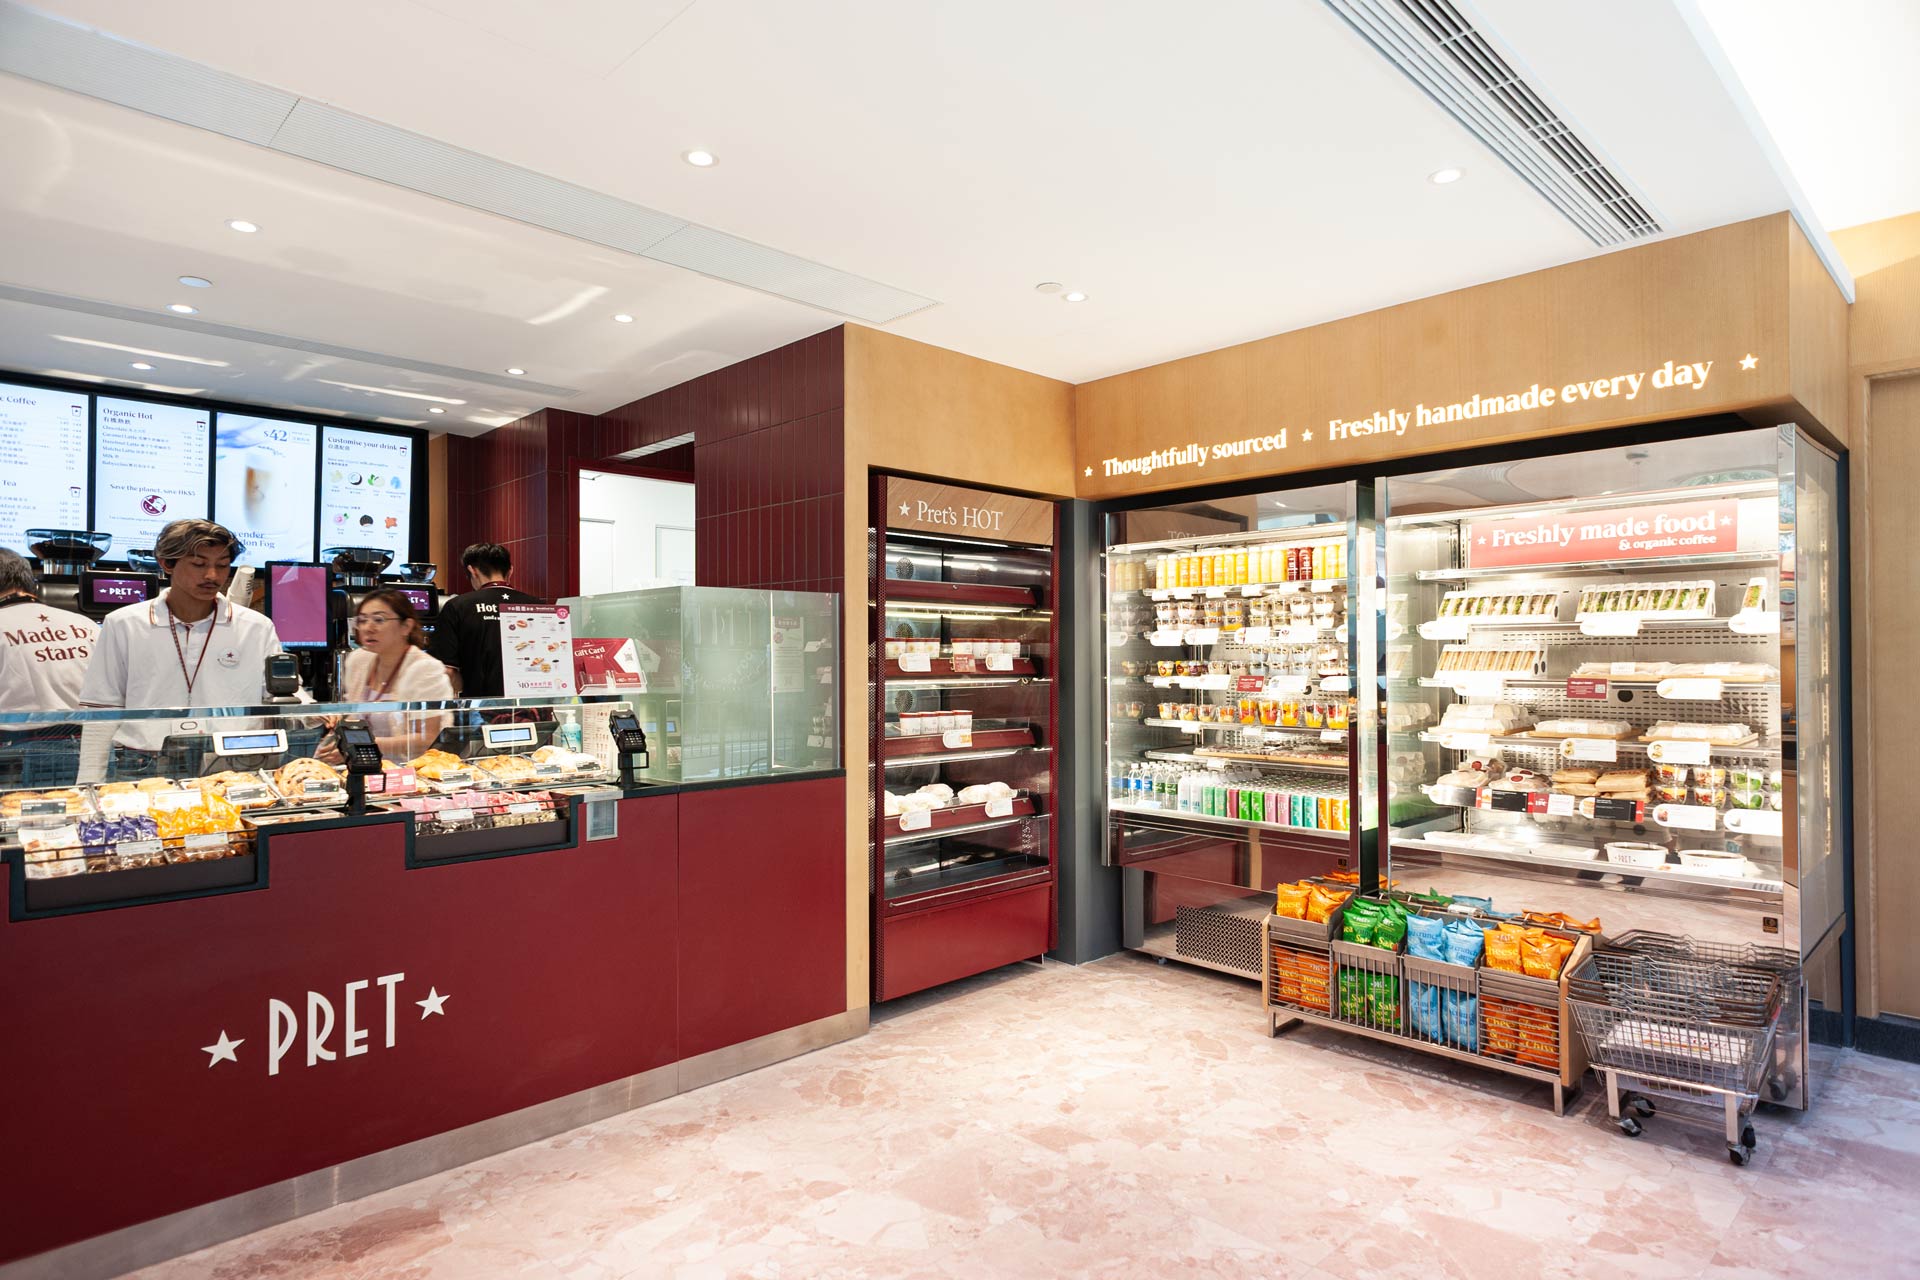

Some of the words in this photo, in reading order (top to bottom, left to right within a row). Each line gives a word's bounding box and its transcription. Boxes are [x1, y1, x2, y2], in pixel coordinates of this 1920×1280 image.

[6, 395, 37, 406] Coffee
[1328, 408, 1412, 441] Freshly
[1415, 383, 1556, 428] handmade
[1560, 371, 1646, 402] every
[1650, 360, 1714, 390] day
[103, 407, 136, 418] Organic
[137, 411, 153, 420] Hot
[328, 436, 362, 447] Customise
[363, 441, 378, 449] your
[379, 443, 398, 451] drink
[1103, 443, 1209, 477] Thoughtfully
[1212, 428, 1288, 460] sourced
[3, 479, 17, 487] Tea
[916, 500, 957, 526] Pret's
[962, 506, 1004, 531] HOT
[1492, 523, 1576, 547] Freshly
[1580, 516, 1650, 541] made
[1654, 510, 1717, 535] food
[259, 540, 275, 549] Fog
[1618, 539, 1632, 551] &
[1633, 536, 1678, 549] organic
[1679, 534, 1717, 546] coffee
[109, 587, 132, 596] PRET
[476, 602, 498, 613] Hot
[3, 626, 68, 647] Made
[34, 645, 89, 663] stars
[574, 648, 589, 657] Gift
[588, 646, 606, 655] Card
[269, 972, 405, 1076] PRET
